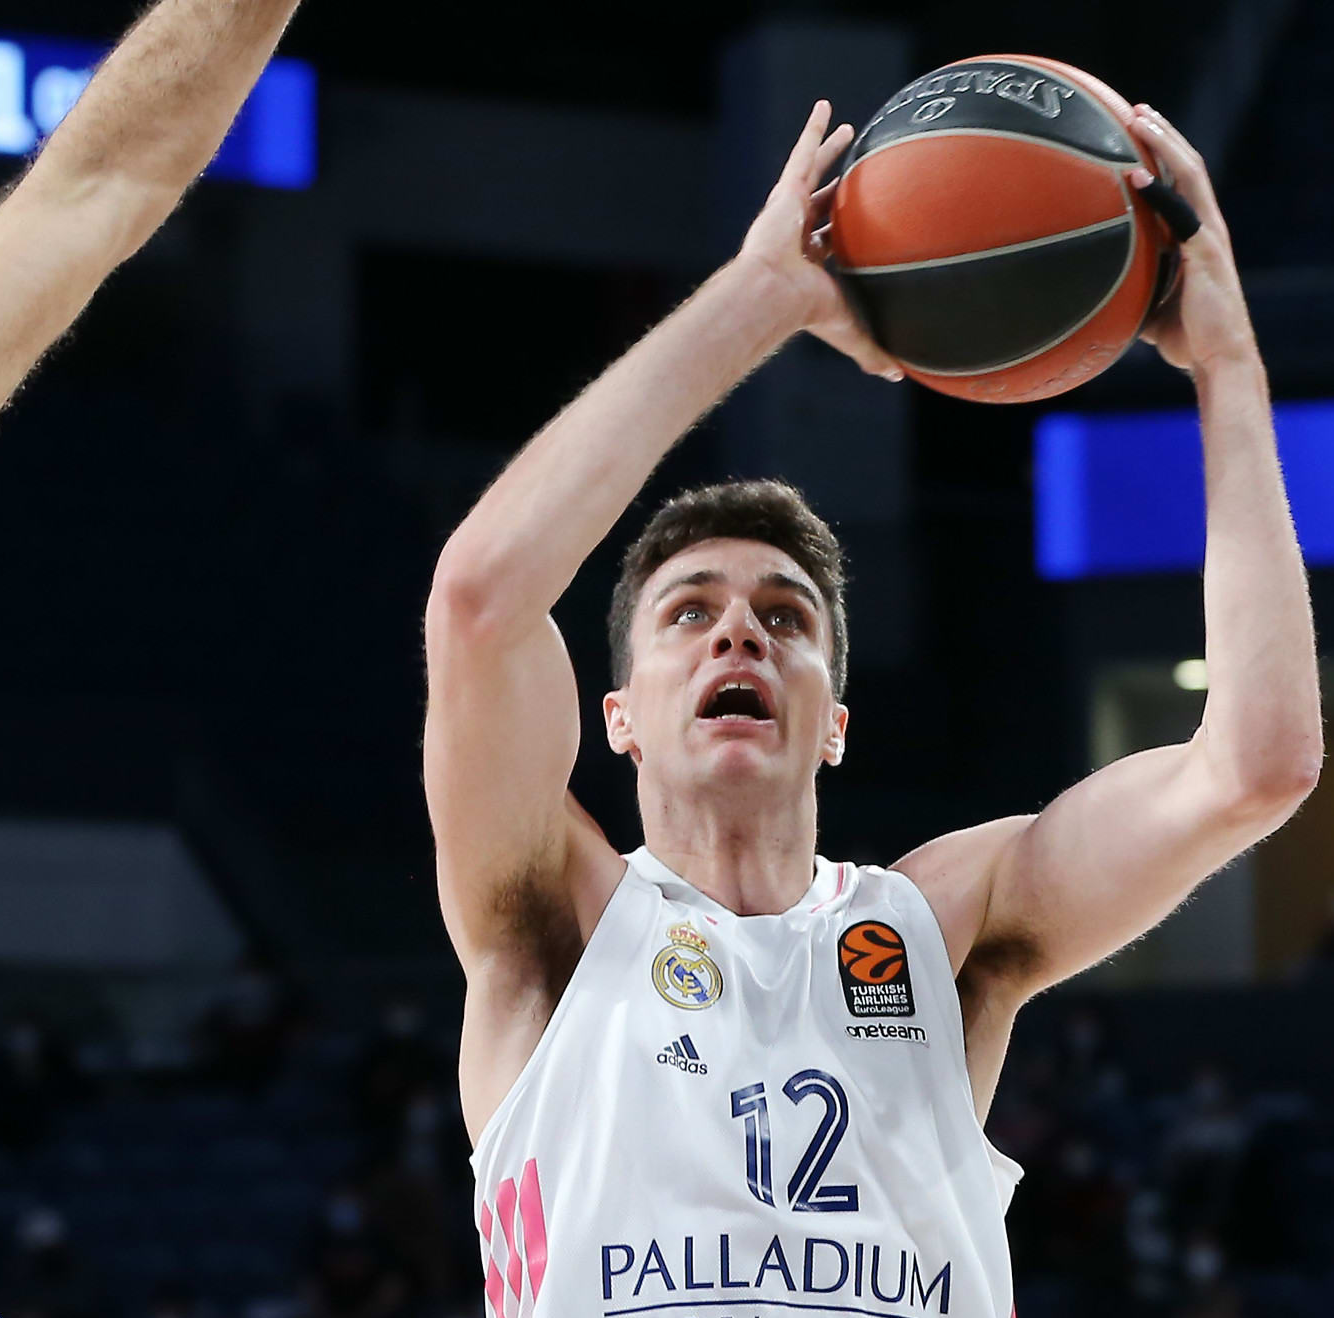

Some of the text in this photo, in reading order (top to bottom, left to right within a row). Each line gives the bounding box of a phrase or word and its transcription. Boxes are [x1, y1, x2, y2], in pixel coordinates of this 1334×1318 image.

[850, 984, 906, 996] TURKISH
[853, 994, 908, 1006] AIRLINES
[854, 1005, 910, 1015] EuroLeague
[846, 1022, 926, 1041] oneteam
[656, 1051, 708, 1075] adidas
[730, 1068, 859, 1213] 12
[601, 1233, 951, 1316] PALLADIUM
